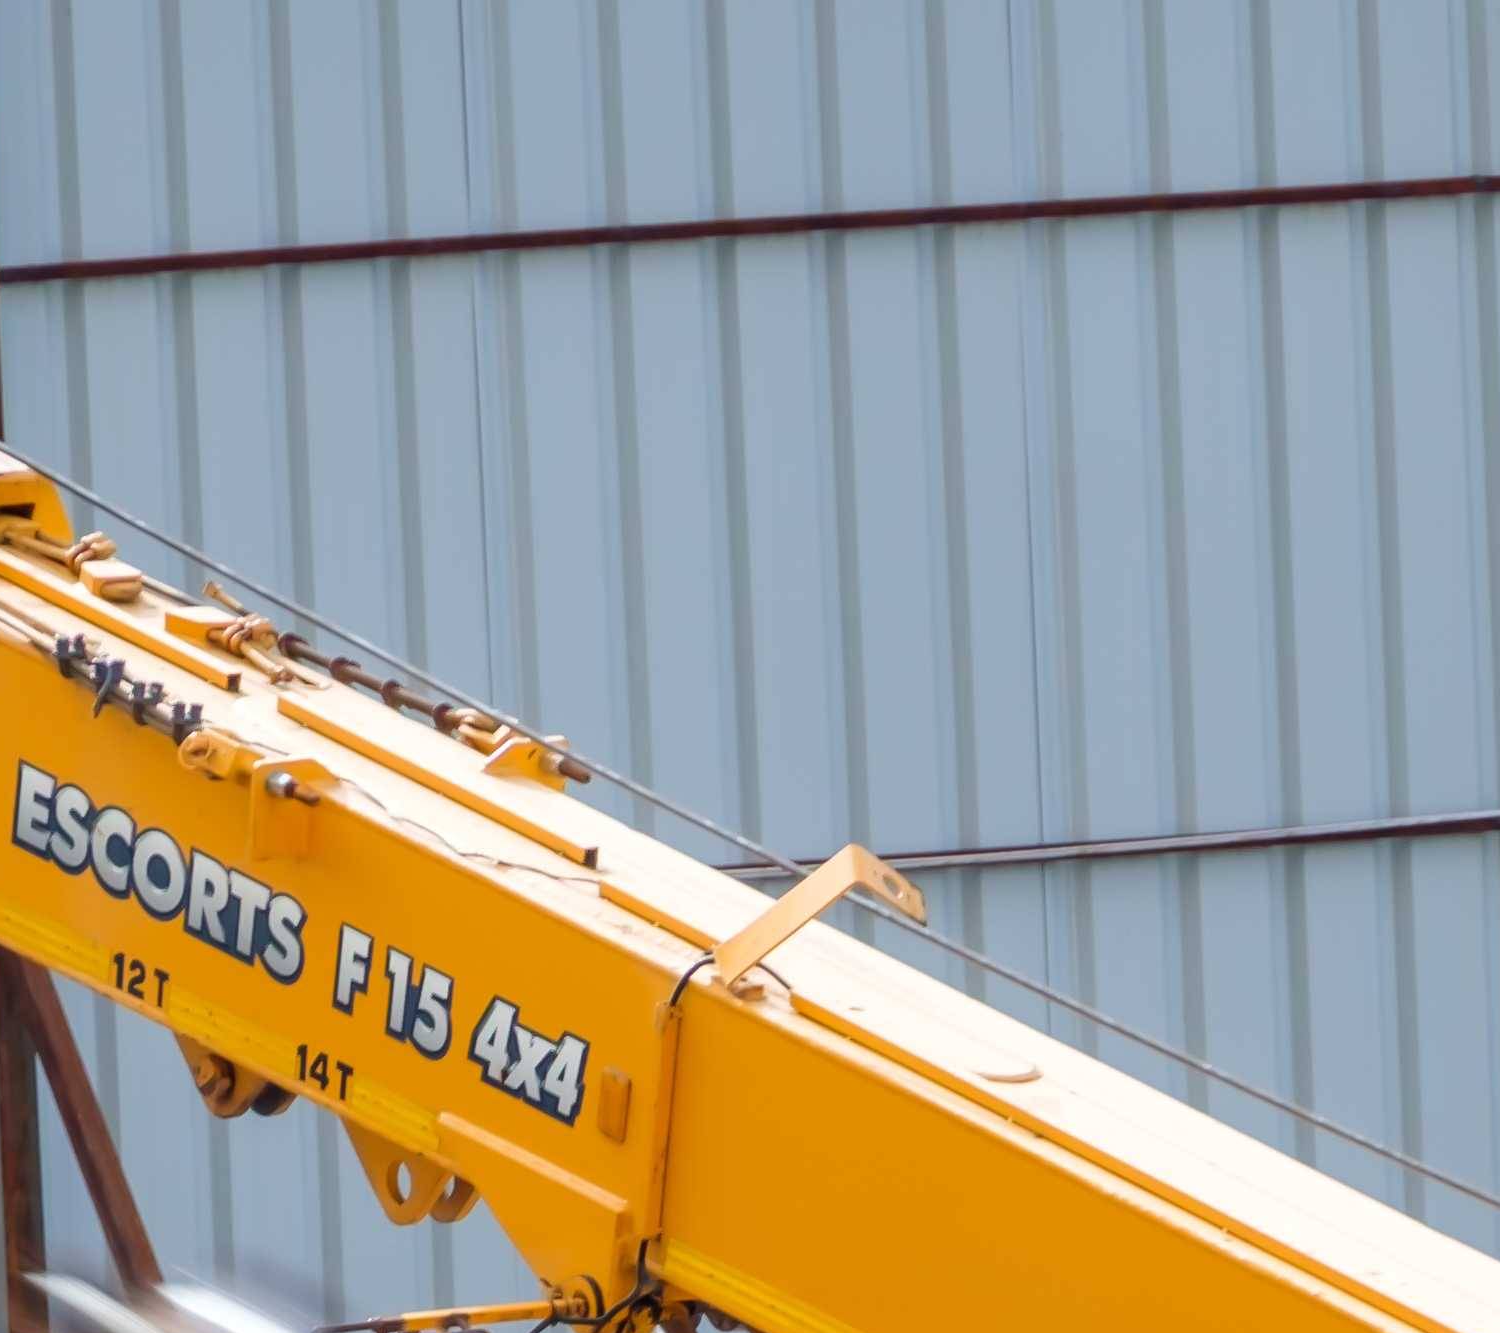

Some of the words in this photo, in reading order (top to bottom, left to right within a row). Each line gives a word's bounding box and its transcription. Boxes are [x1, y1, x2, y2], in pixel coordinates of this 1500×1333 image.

[12, 758, 307, 985] ESCORTS
[332, 921, 374, 1016] F
[385, 945, 454, 1061] 15
